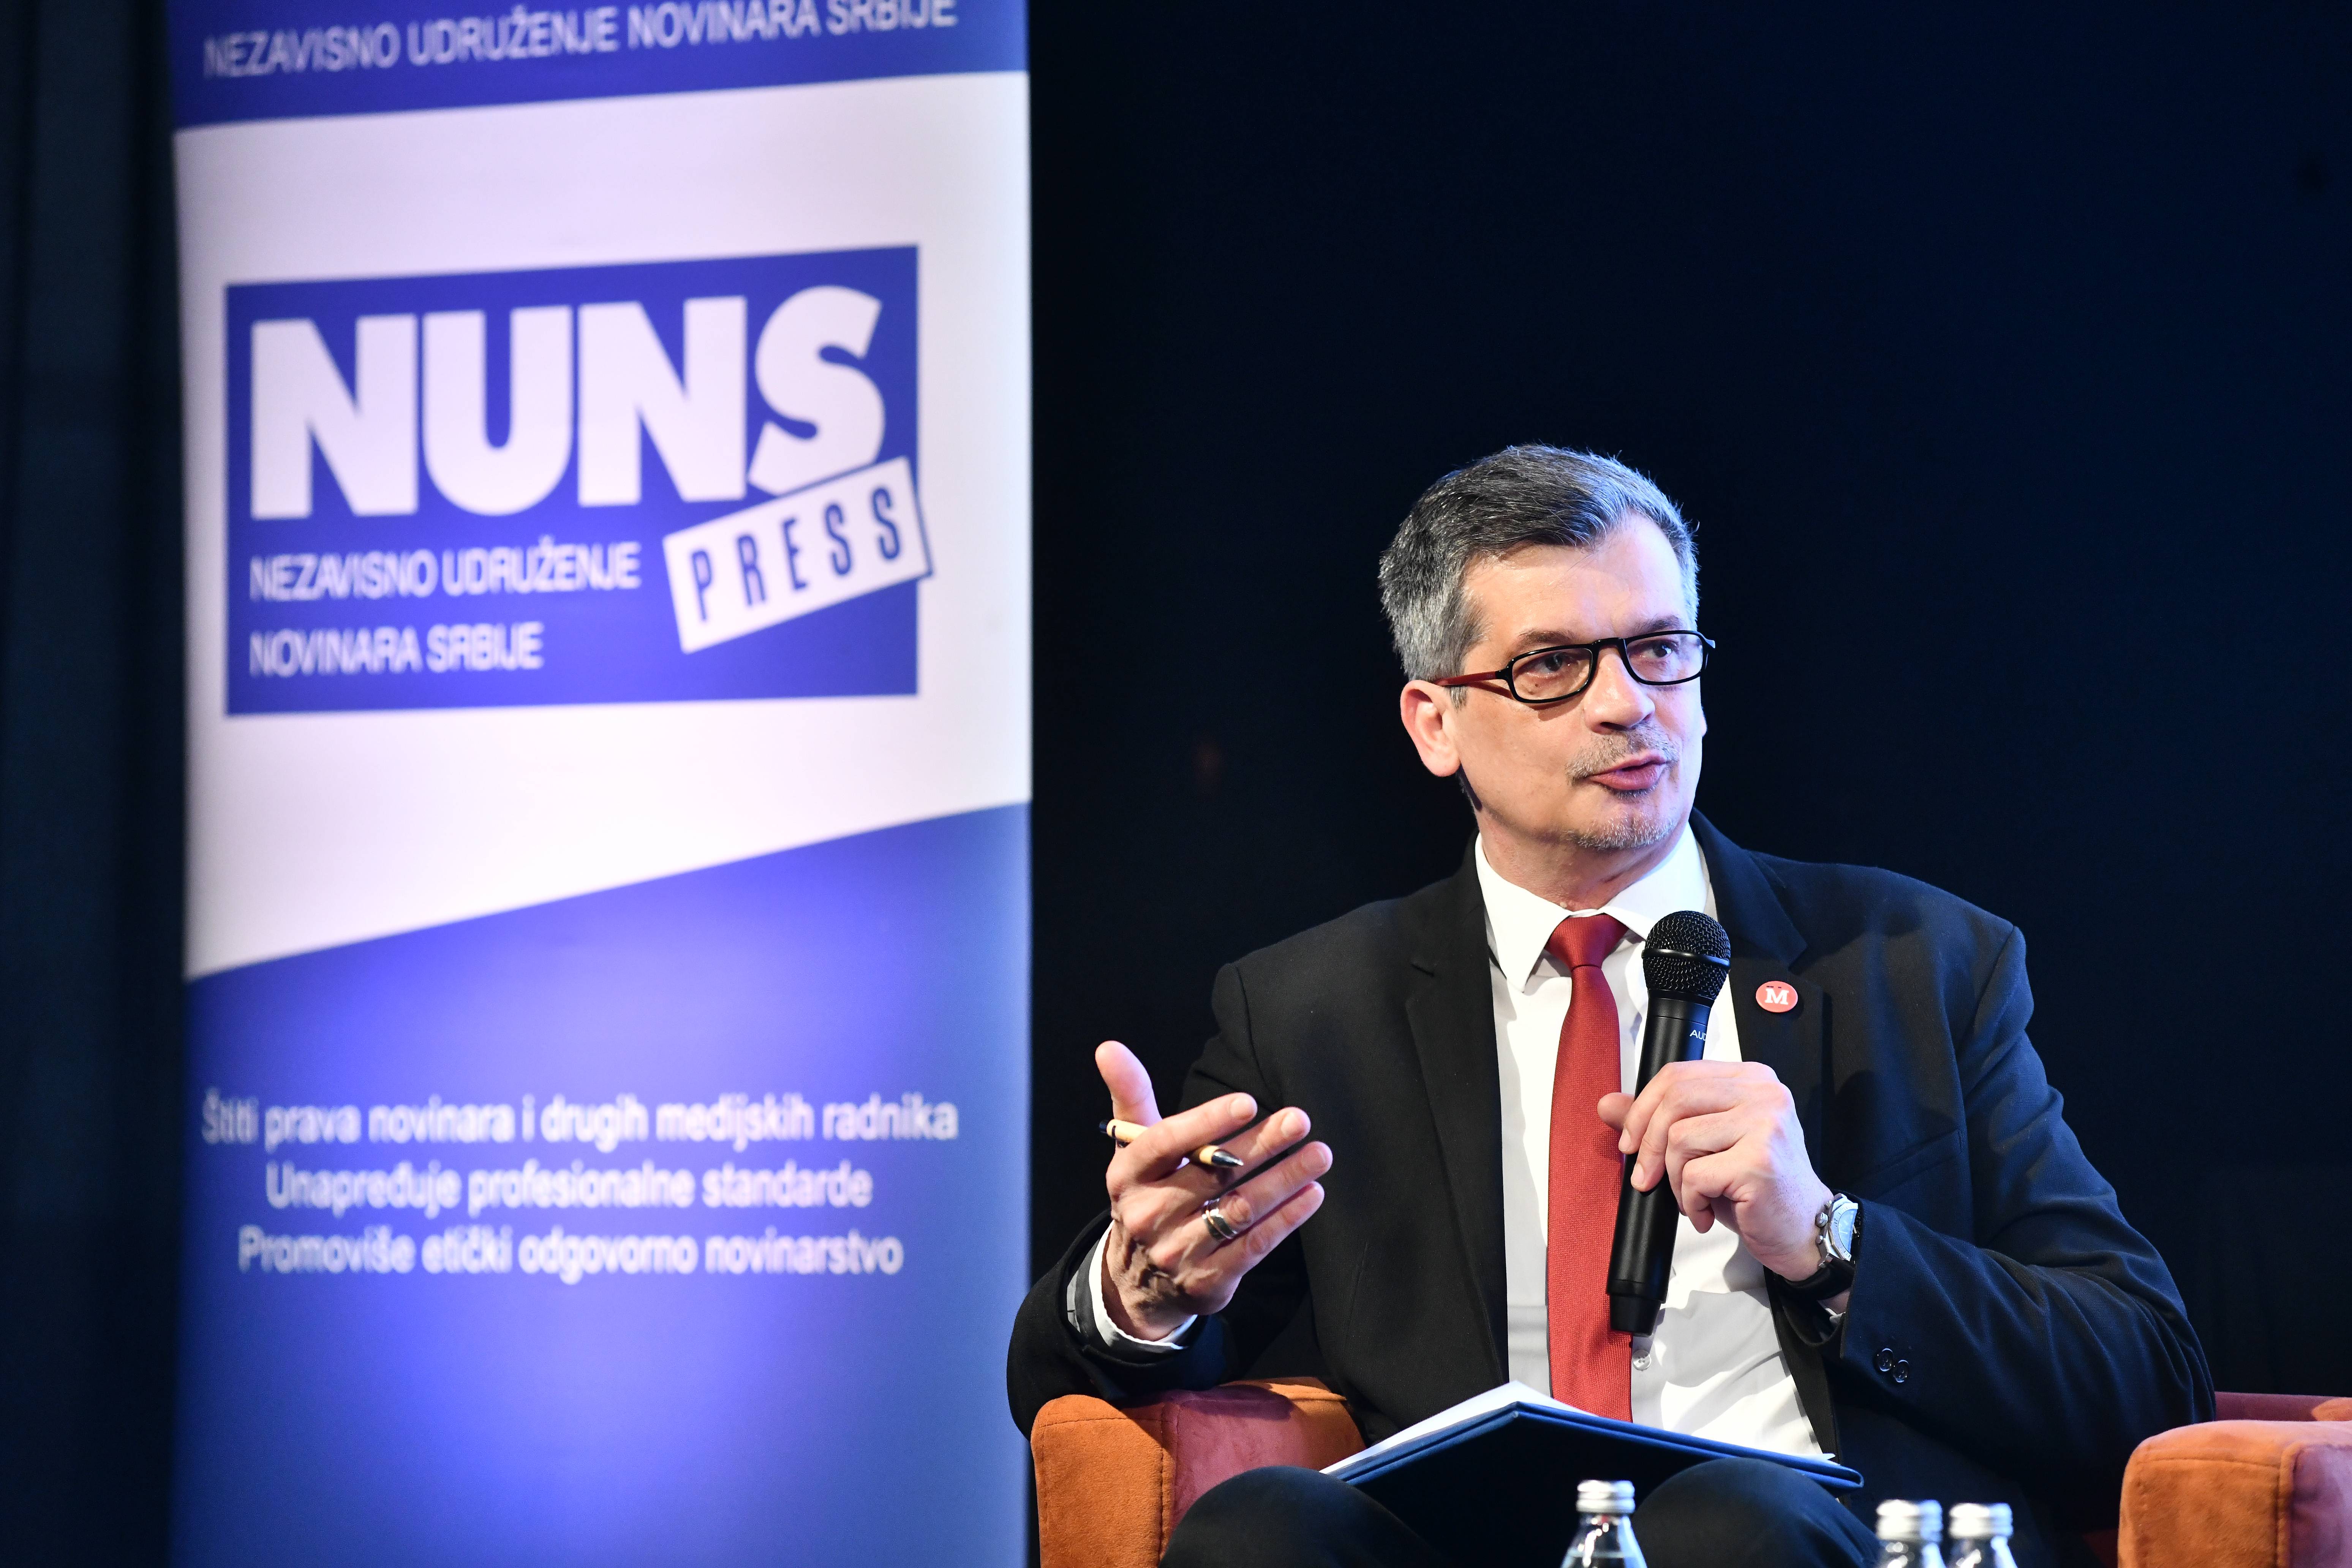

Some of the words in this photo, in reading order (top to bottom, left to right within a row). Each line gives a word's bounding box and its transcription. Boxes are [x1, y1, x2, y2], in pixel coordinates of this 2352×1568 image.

[204, 21, 401, 78] NEZAVISNO
[406, 4, 618, 66] UDRUŽENJE
[627, 0, 822, 49] NOVINARA
[826, 0, 958, 35] SRBIJE
[251, 285, 885, 520] NUNS
[249, 548, 438, 602] NEZAVISNO
[441, 534, 642, 597] UDRUŽENJE
[691, 486, 902, 621] PRESS
[249, 626, 423, 678] NOVINARA
[426, 621, 545, 675] SRBIJE
[1765, 988, 1789, 1005] M
[264, 1103, 361, 1153] prava
[368, 1094, 516, 1143] novinara
[522, 1094, 535, 1142] i
[540, 1093, 649, 1152] drugih
[656, 1092, 815, 1152] medijskih
[822, 1092, 959, 1142] radnika
[265, 1159, 462, 1219] Unapređuje
[467, 1159, 695, 1219] profesionalne
[702, 1159, 874, 1208] standarde
[238, 1225, 416, 1274] Promoviše
[421, 1225, 513, 1274] etički
[518, 1225, 699, 1285] odgovorno
[705, 1225, 905, 1276] novinarstvo
